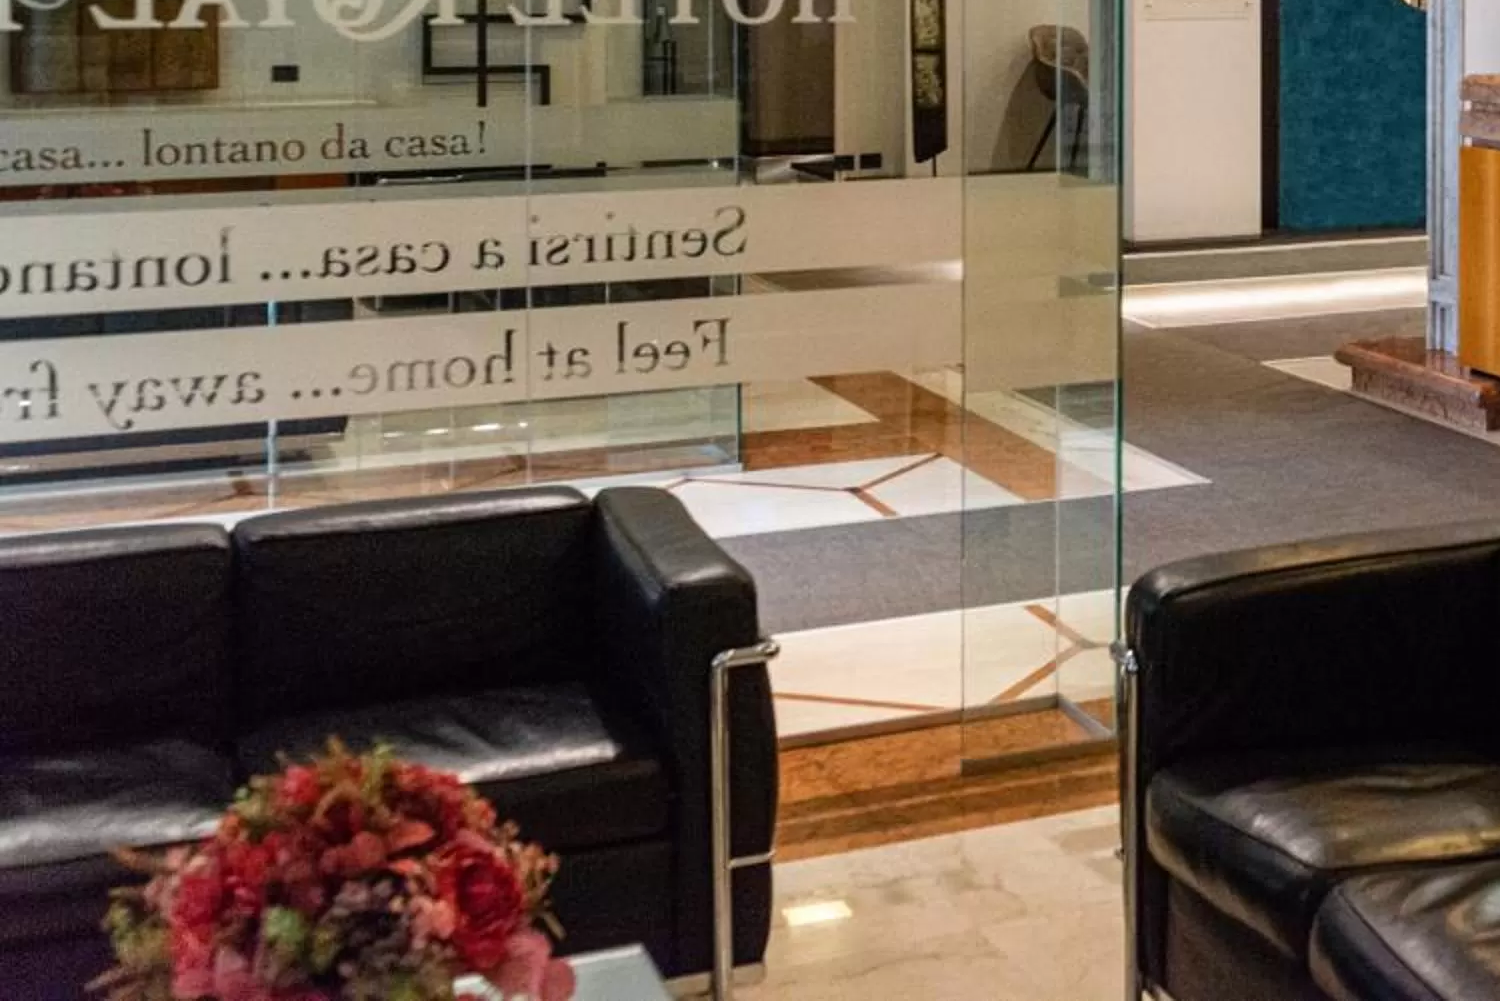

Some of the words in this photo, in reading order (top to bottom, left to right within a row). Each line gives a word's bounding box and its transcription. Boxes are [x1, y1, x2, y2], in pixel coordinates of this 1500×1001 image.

[142, 128, 306, 167] lontano
[320, 122, 371, 160] da
[384, 120, 487, 159] casa!
